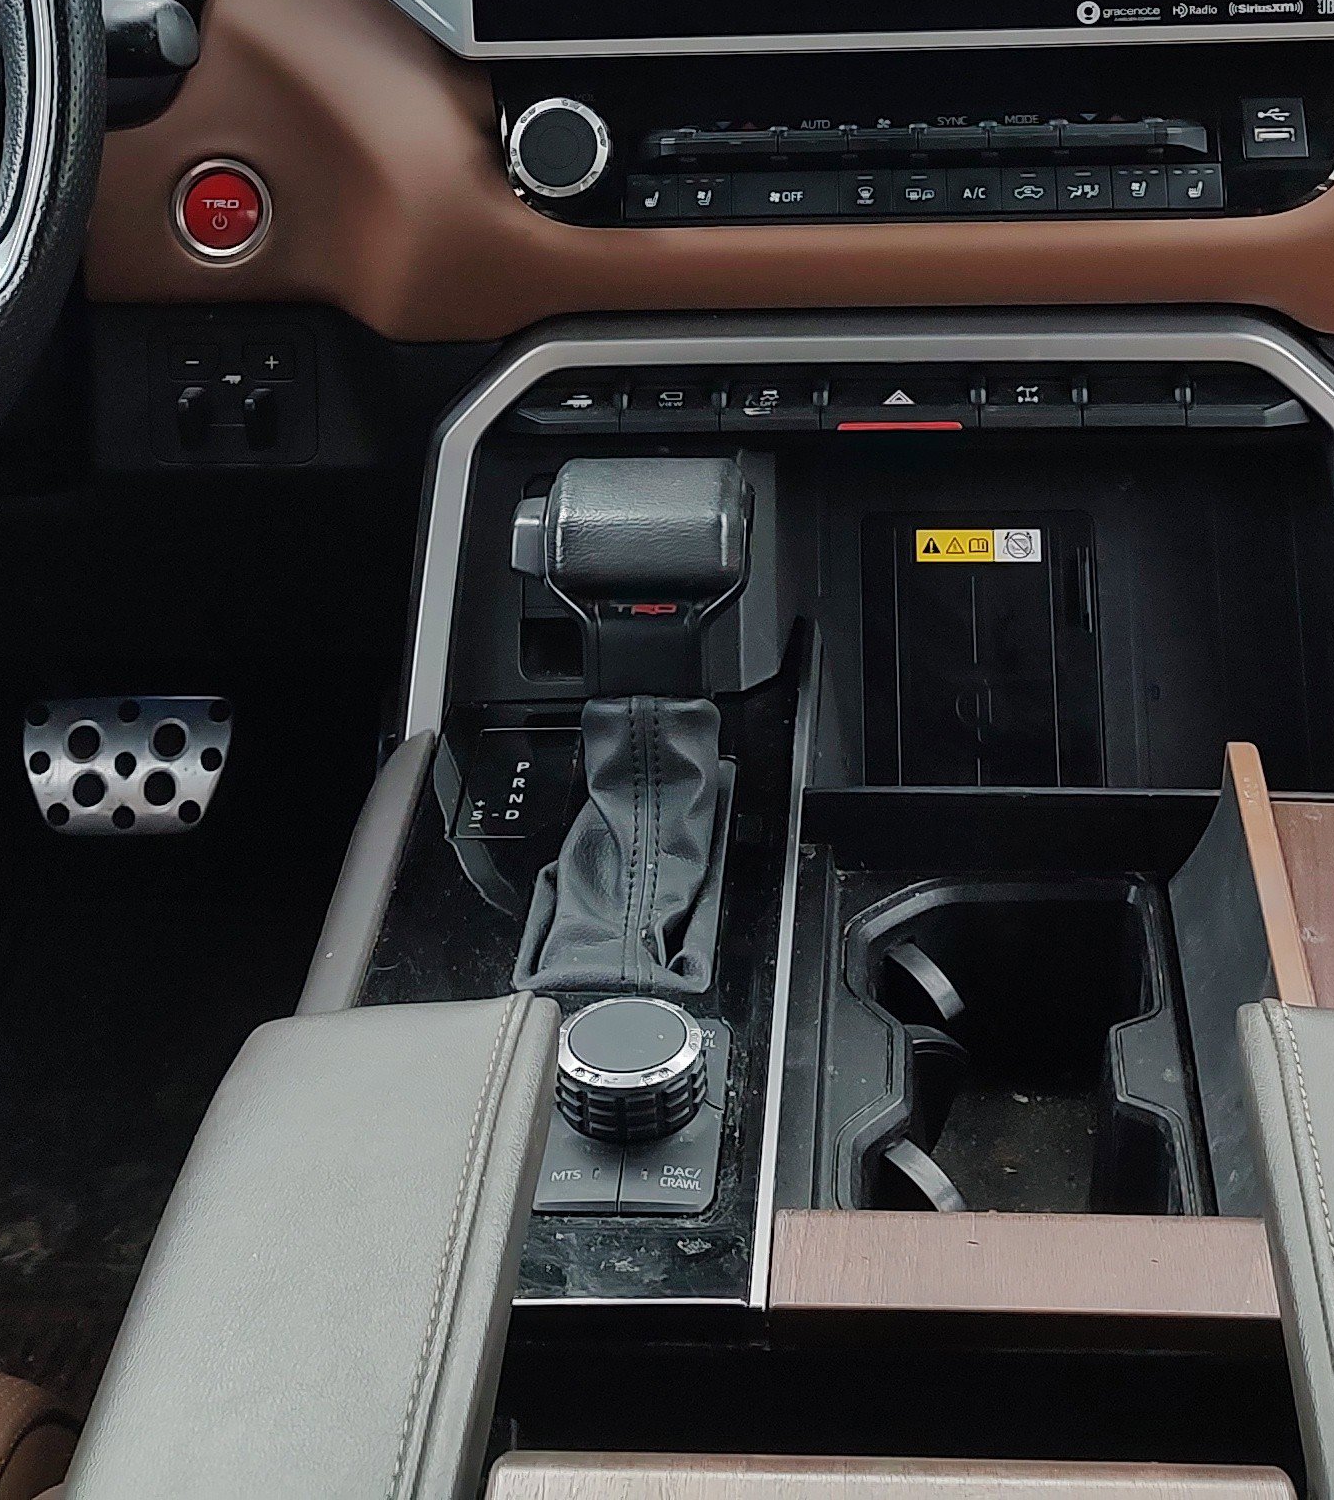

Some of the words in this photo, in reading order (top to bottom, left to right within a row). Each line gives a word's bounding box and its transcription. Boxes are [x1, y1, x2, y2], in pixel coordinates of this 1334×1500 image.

[1102, 6, 1161, 19] gracenote
[1189, 4, 1218, 15] Radio
[799, 119, 831, 130] AUTO
[936, 116, 968, 127] SYNC
[1004, 114, 1039, 125] MODE
[781, 191, 804, 203] OFF
[962, 187, 987, 200] A/C
[201, 198, 240, 209] TRD
[516, 761, 531, 774] P
[512, 777, 526, 788] R
[508, 793, 524, 804] N
[504, 809, 520, 820] D
[550, 1169, 582, 1182] MTS
[662, 1165, 702, 1179] DAC/
[659, 1176, 702, 1191] CRAWL
